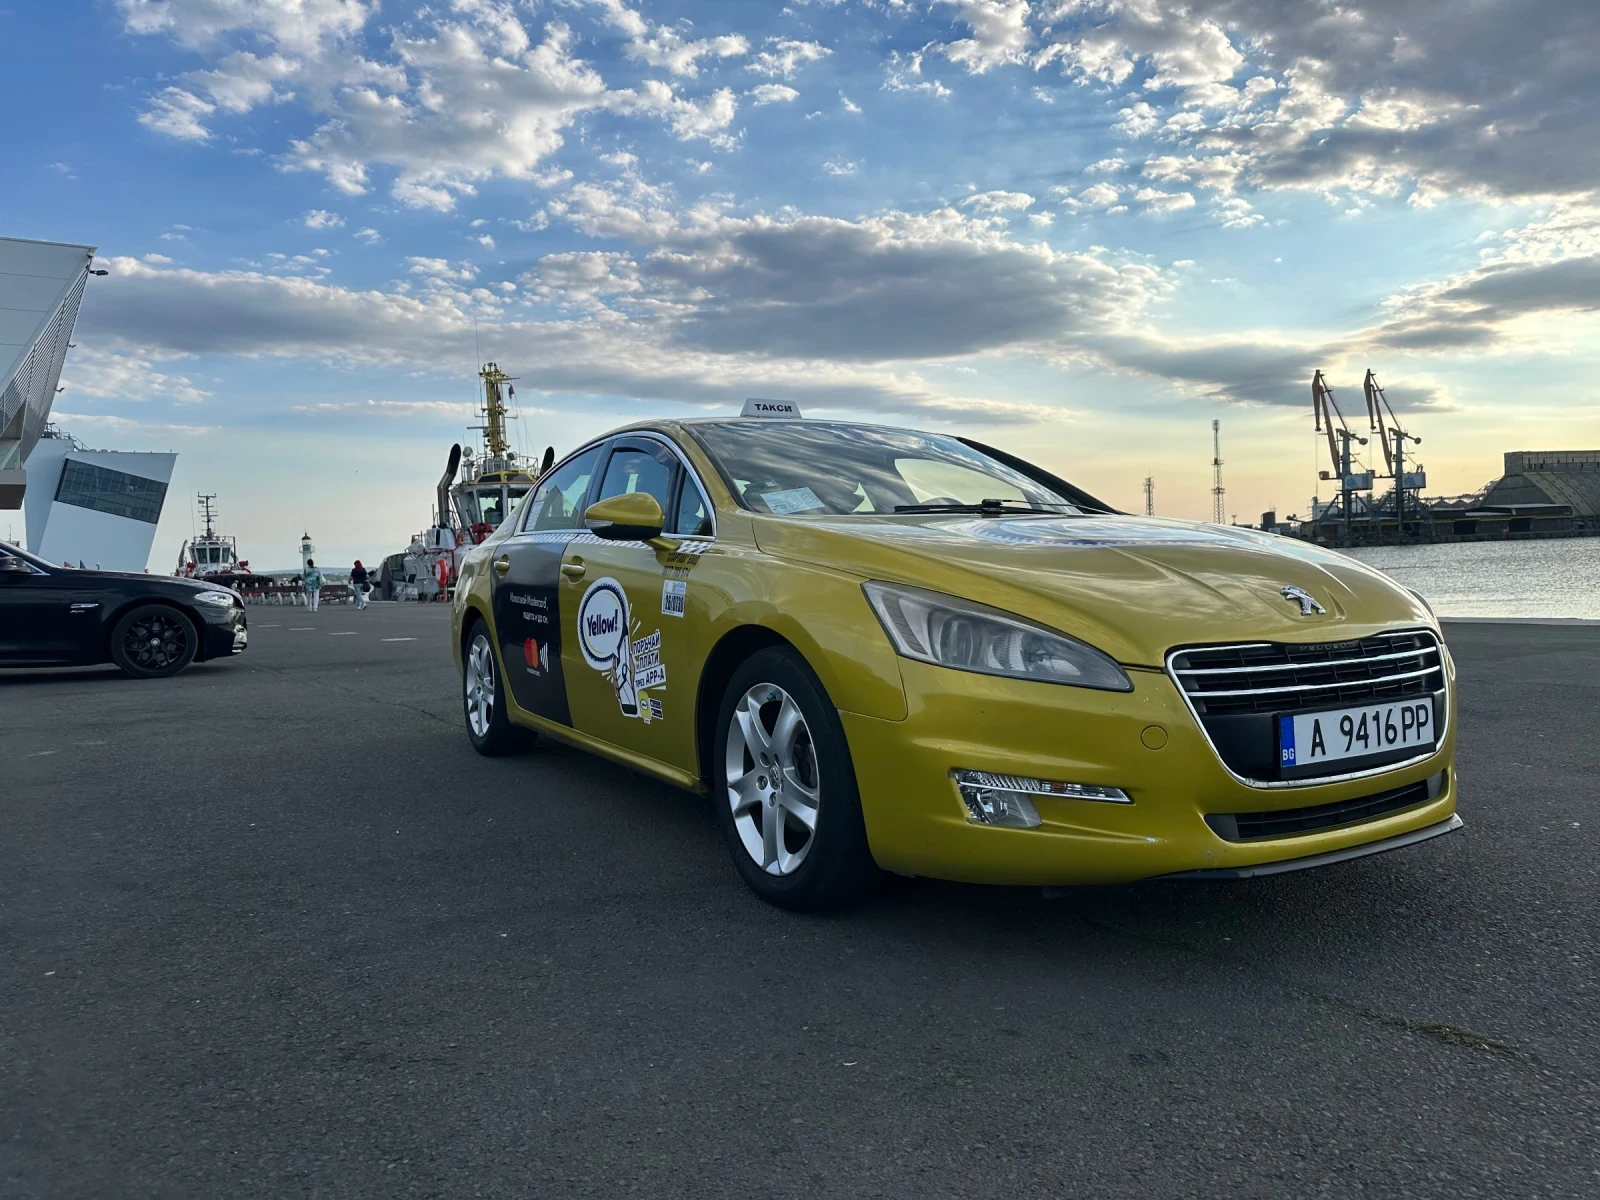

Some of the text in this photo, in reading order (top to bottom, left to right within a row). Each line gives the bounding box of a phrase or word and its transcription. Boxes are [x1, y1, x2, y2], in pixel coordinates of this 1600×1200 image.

[754, 403, 792, 412] ТАКСИ
[586, 609, 619, 637] Yellow!
[633, 630, 660, 655] ПОРЪЧАЙ
[639, 651, 659, 670] ПЛАТИ
[1310, 718, 1326, 757] A
[1282, 748, 1295, 760] BG
